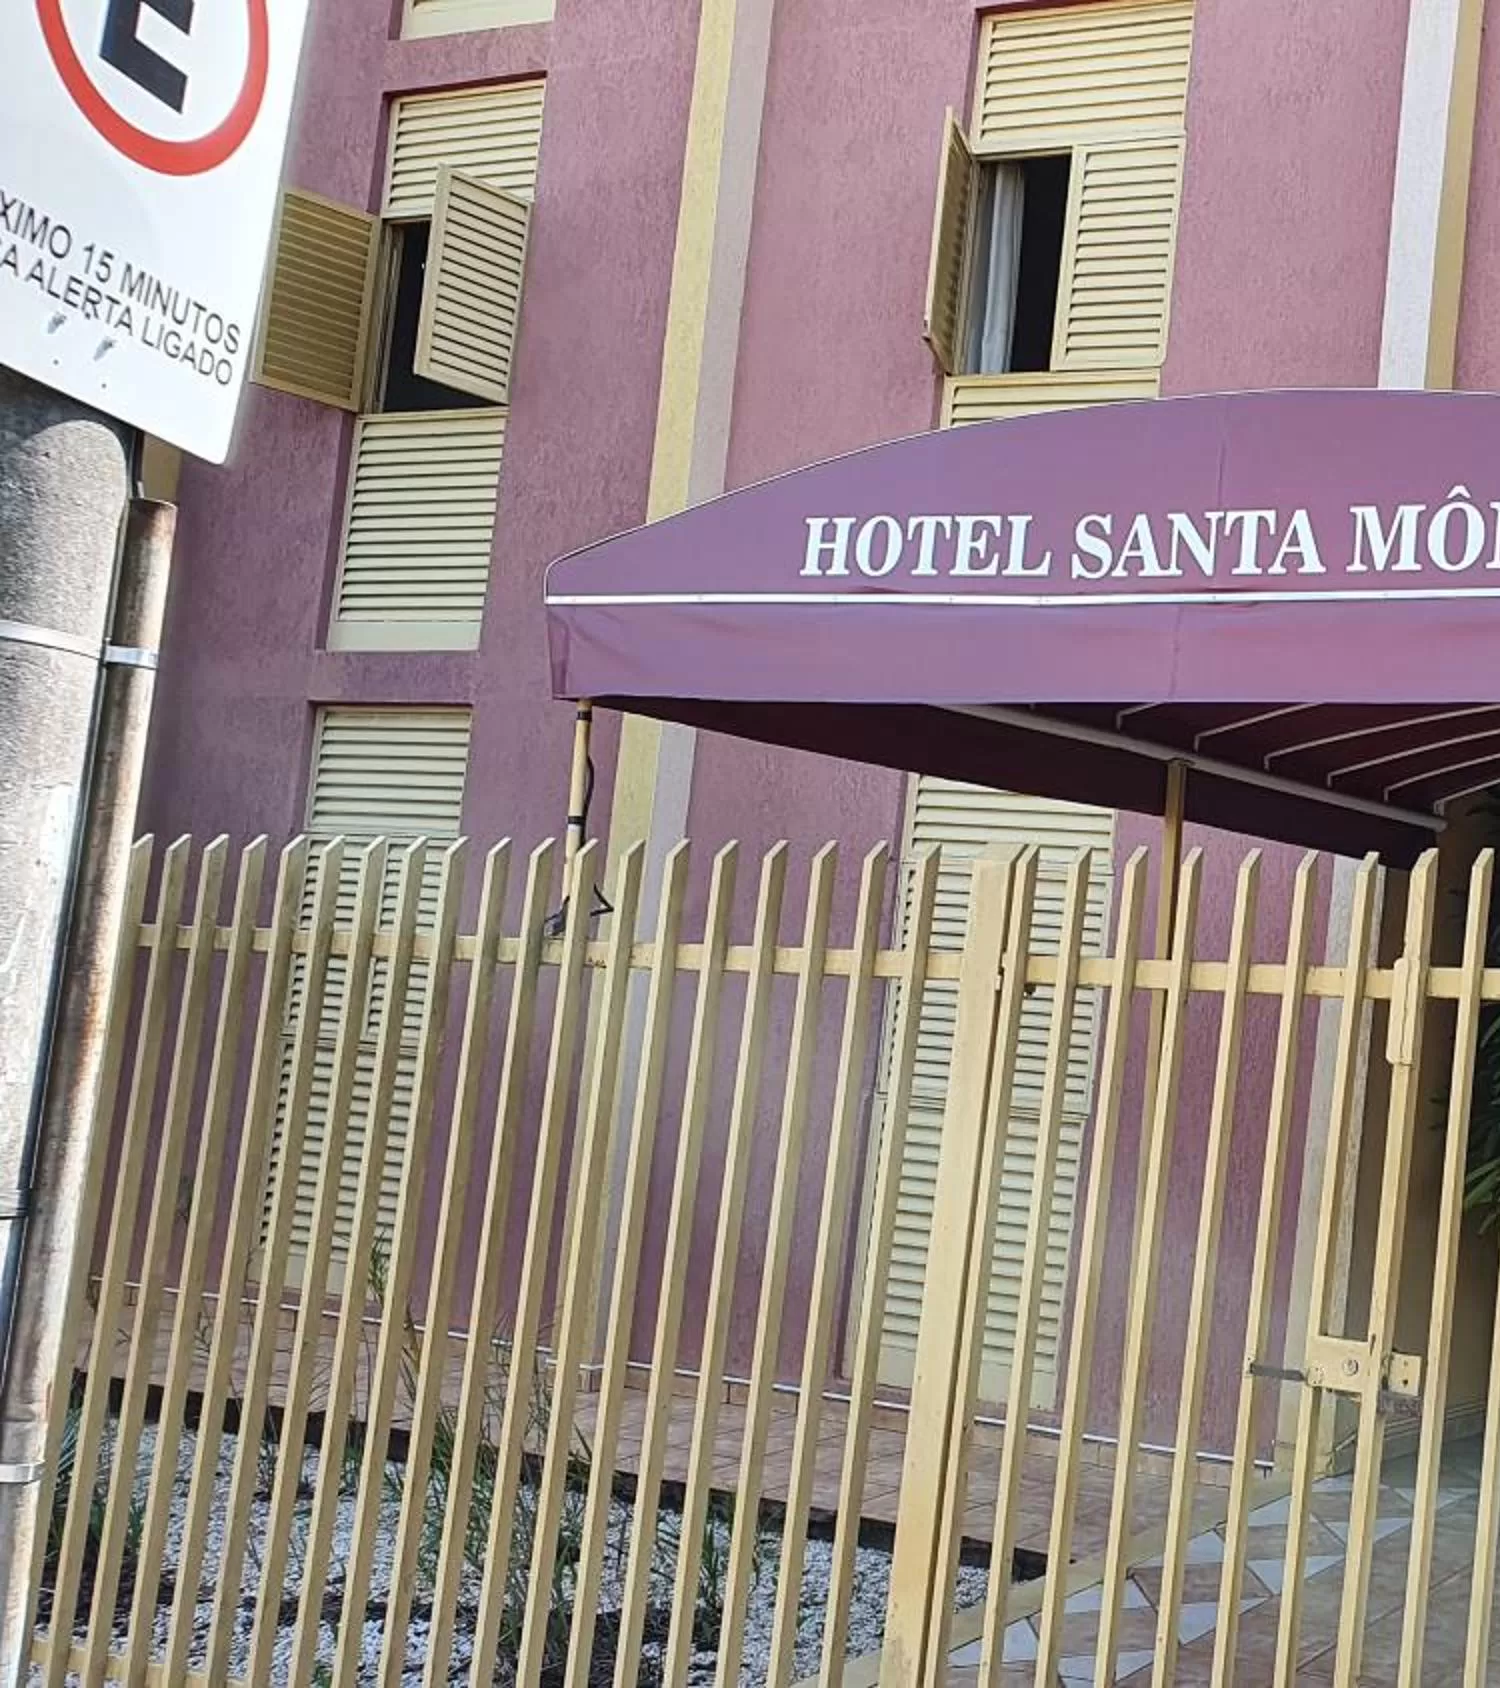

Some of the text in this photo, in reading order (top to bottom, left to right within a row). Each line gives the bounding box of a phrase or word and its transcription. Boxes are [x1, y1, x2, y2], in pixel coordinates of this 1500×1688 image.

[24, 257, 133, 337] ALERTA
[141, 315, 232, 386] LIGADO
[83, 244, 114, 283] 15
[120, 262, 241, 354] MINUTOS
[799, 514, 1052, 577] HOTEL
[1071, 508, 1327, 580] SANTA
